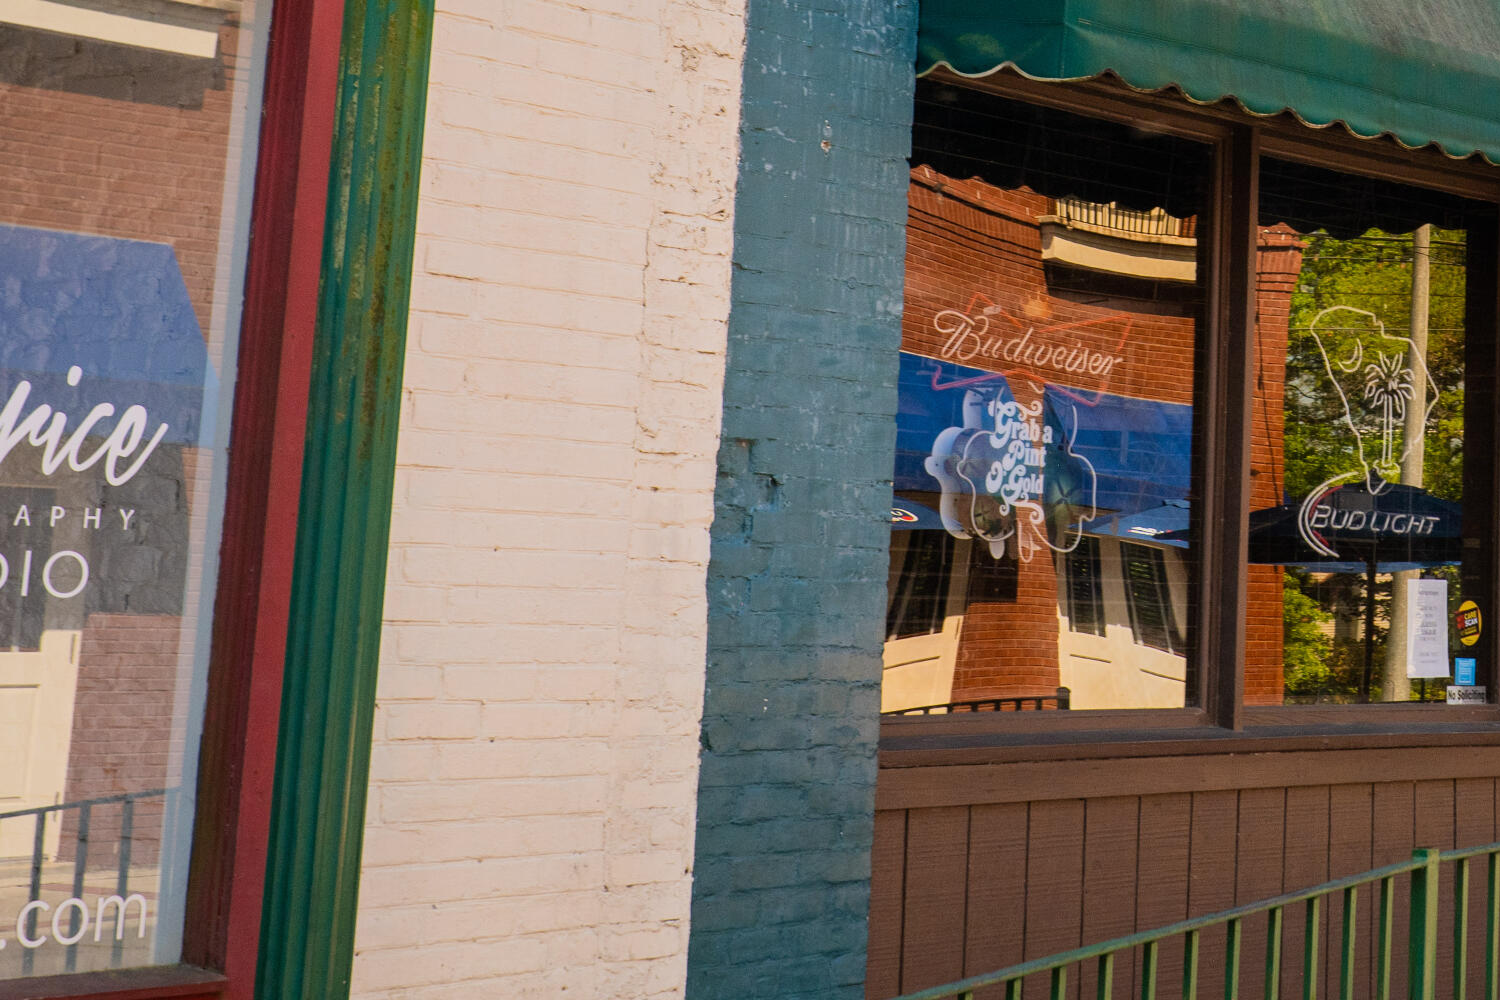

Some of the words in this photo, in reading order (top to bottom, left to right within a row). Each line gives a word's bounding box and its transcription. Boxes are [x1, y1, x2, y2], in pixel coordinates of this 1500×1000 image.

[934, 310, 1124, 375] Budweiser
[988, 402, 1041, 449] Grab
[1042, 425, 1053, 444] a
[1002, 440, 1048, 472] Pint
[1001, 465, 1045, 502] Gold
[13, 505, 135, 530] APHY
[1309, 504, 1367, 532] BUD
[1370, 513, 1441, 535] LIGHT
[0, 550, 89, 599] IO
